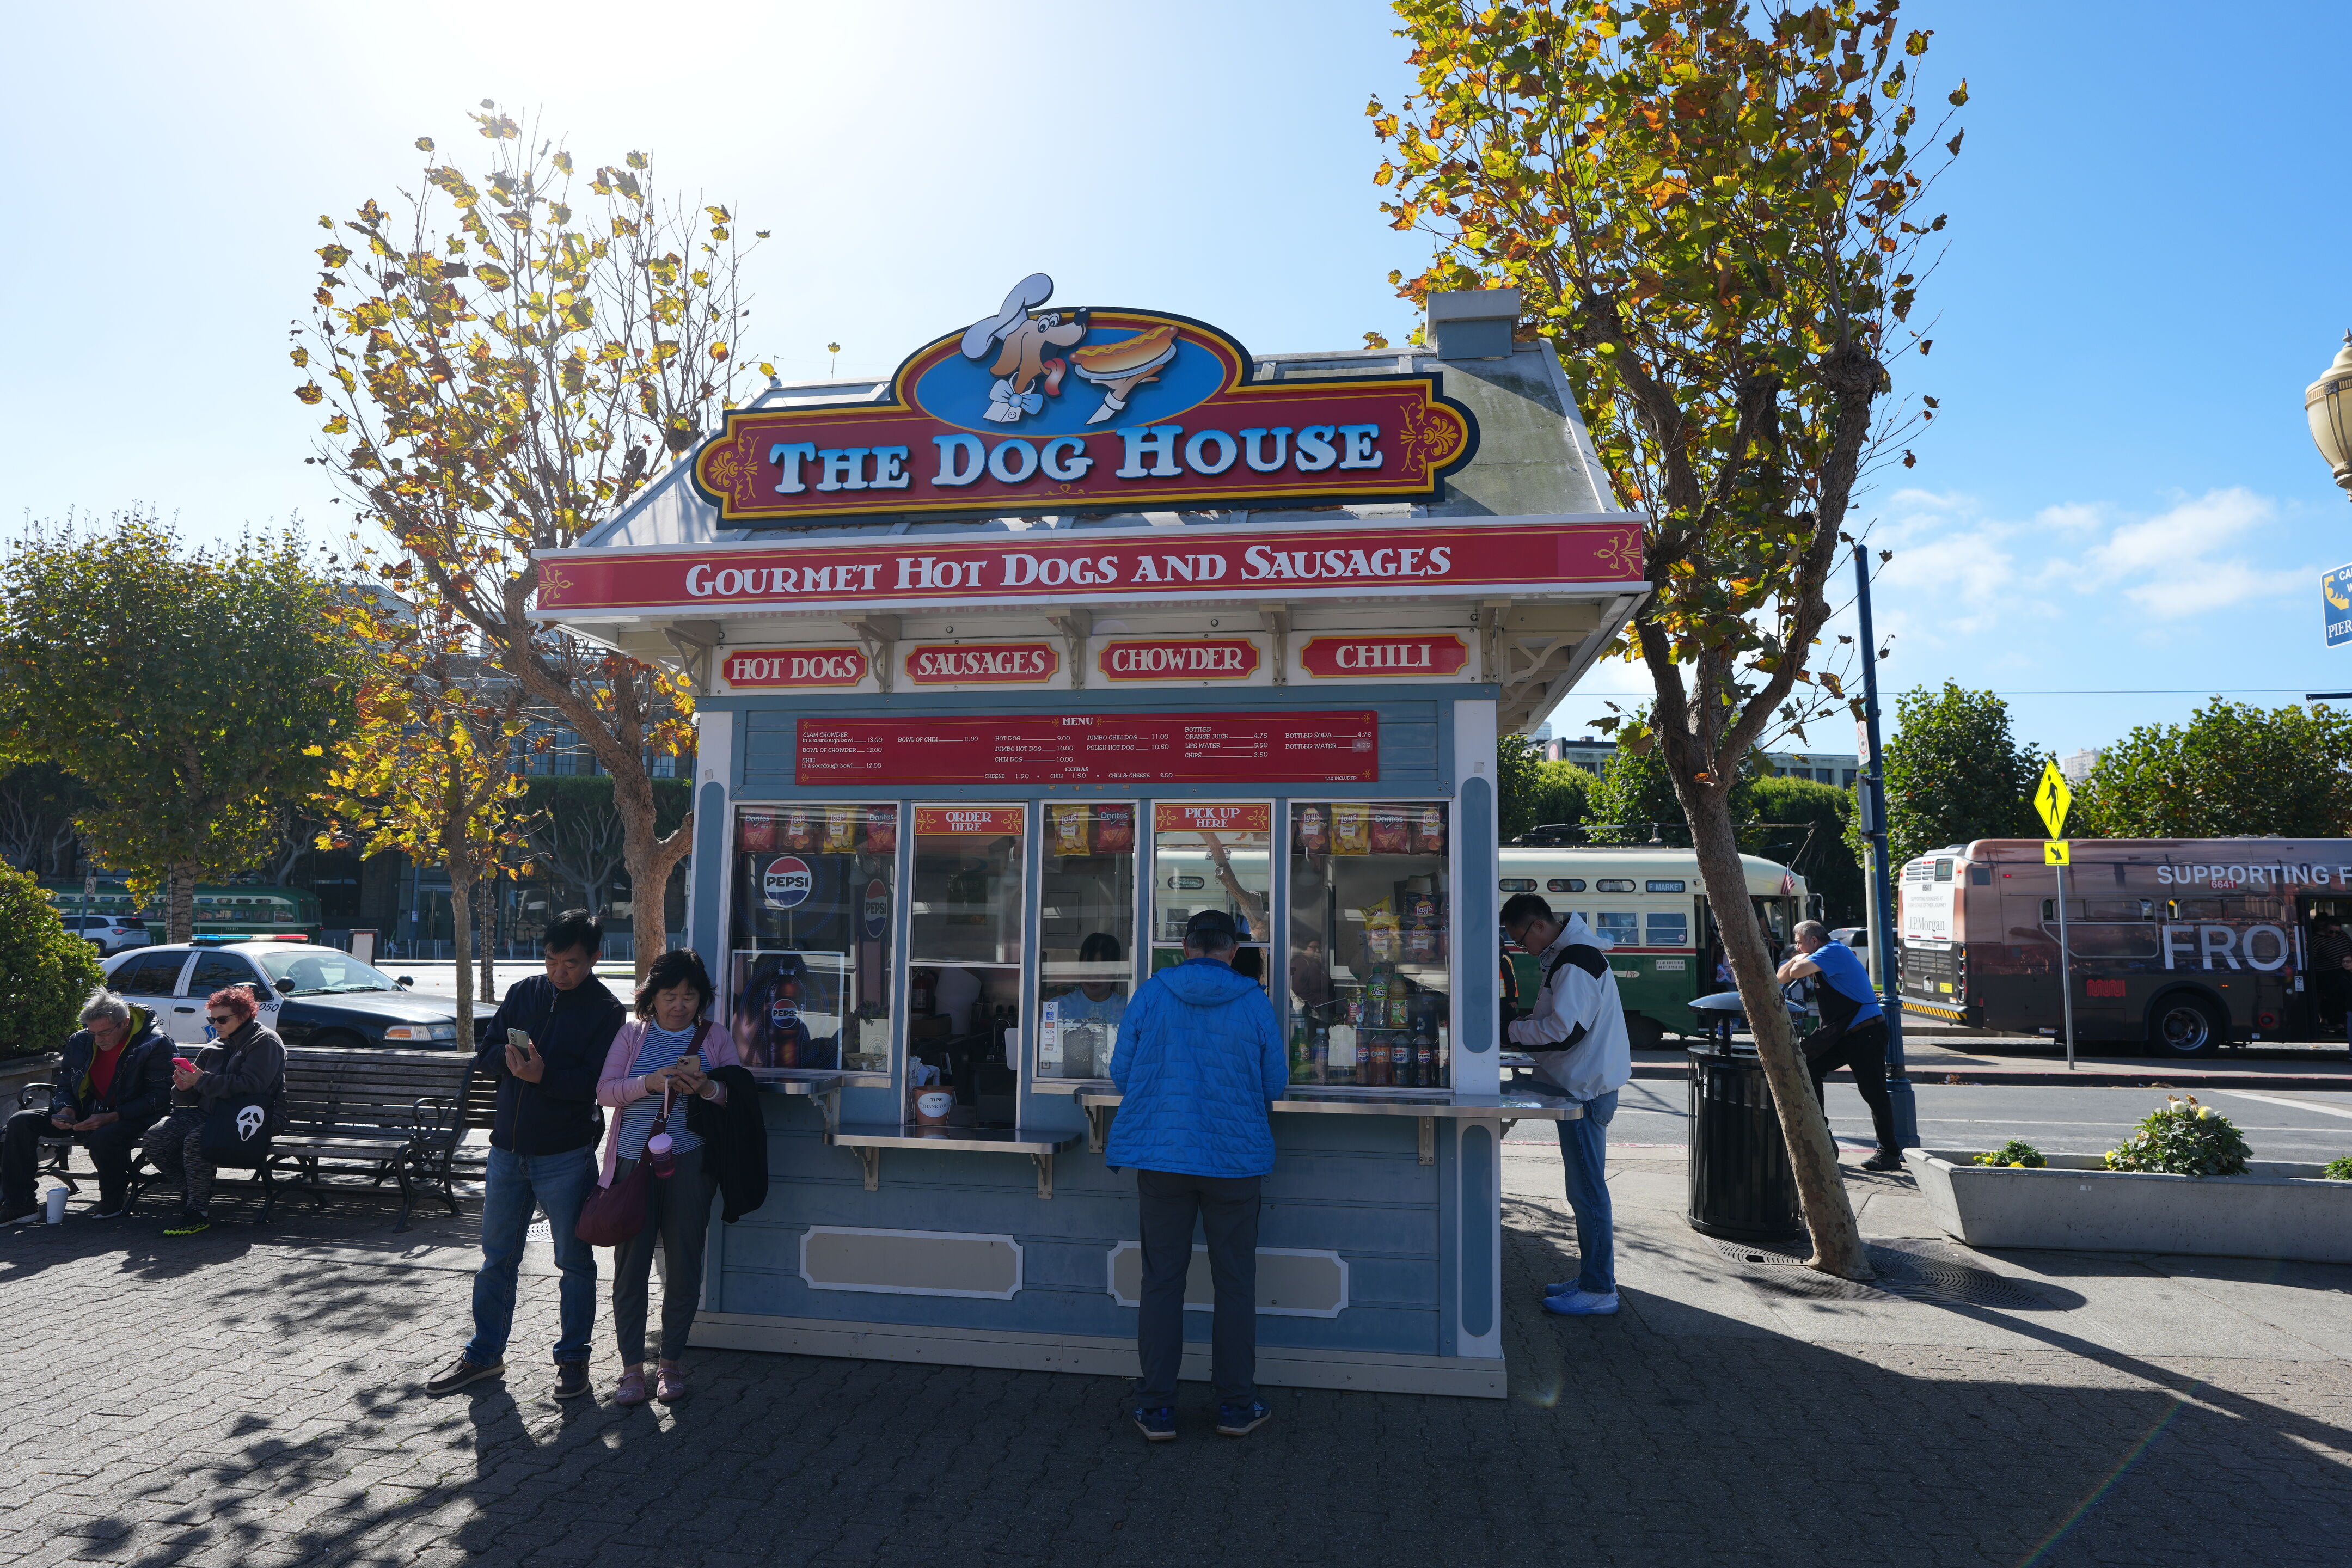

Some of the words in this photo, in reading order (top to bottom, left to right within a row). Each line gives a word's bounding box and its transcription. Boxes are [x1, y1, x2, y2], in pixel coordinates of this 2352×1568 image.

[769, 442, 910, 494] THE
[931, 432, 1094, 486] DOG
[1115, 421, 1382, 481] HOUSE
[685, 563, 883, 597] GOURMET
[894, 556, 988, 589] HOT
[1000, 553, 1118, 586] DOGS
[1131, 554, 1227, 582] AND
[1241, 545, 1451, 580] SAUSAGES
[1112, 647, 1244, 671] CHOWDER
[1336, 644, 1432, 667] CHILI
[732, 657, 784, 679] HOT
[791, 655, 857, 678] DOGS
[917, 651, 1046, 676] SAUSAGES
[830, 812, 845, 823] Lay's
[869, 813, 894, 822] Doritos
[946, 812, 991, 822] ORDER
[1184, 808, 1216, 818] PICK
[1220, 807, 1241, 818] UP
[1303, 812, 1319, 823] Lay's
[791, 813, 806, 824] Lay's
[1061, 813, 1077, 824] Lay's
[1196, 819, 1228, 828] HERE
[1341, 813, 1357, 824] Lay's
[1375, 814, 1403, 823] Doritos
[951, 823, 981, 831] HERE
[2157, 866, 2330, 884] SUPPORTING
[767, 877, 809, 887] PEPSI
[1656, 883, 1683, 891] MARKET
[2212, 880, 2234, 889] 6641
[866, 902, 886, 914] PEPSI
[1416, 904, 1432, 915] Lay's
[1908, 917, 1945, 936] J.P.Morgan
[1371, 987, 1387, 996] Starry
